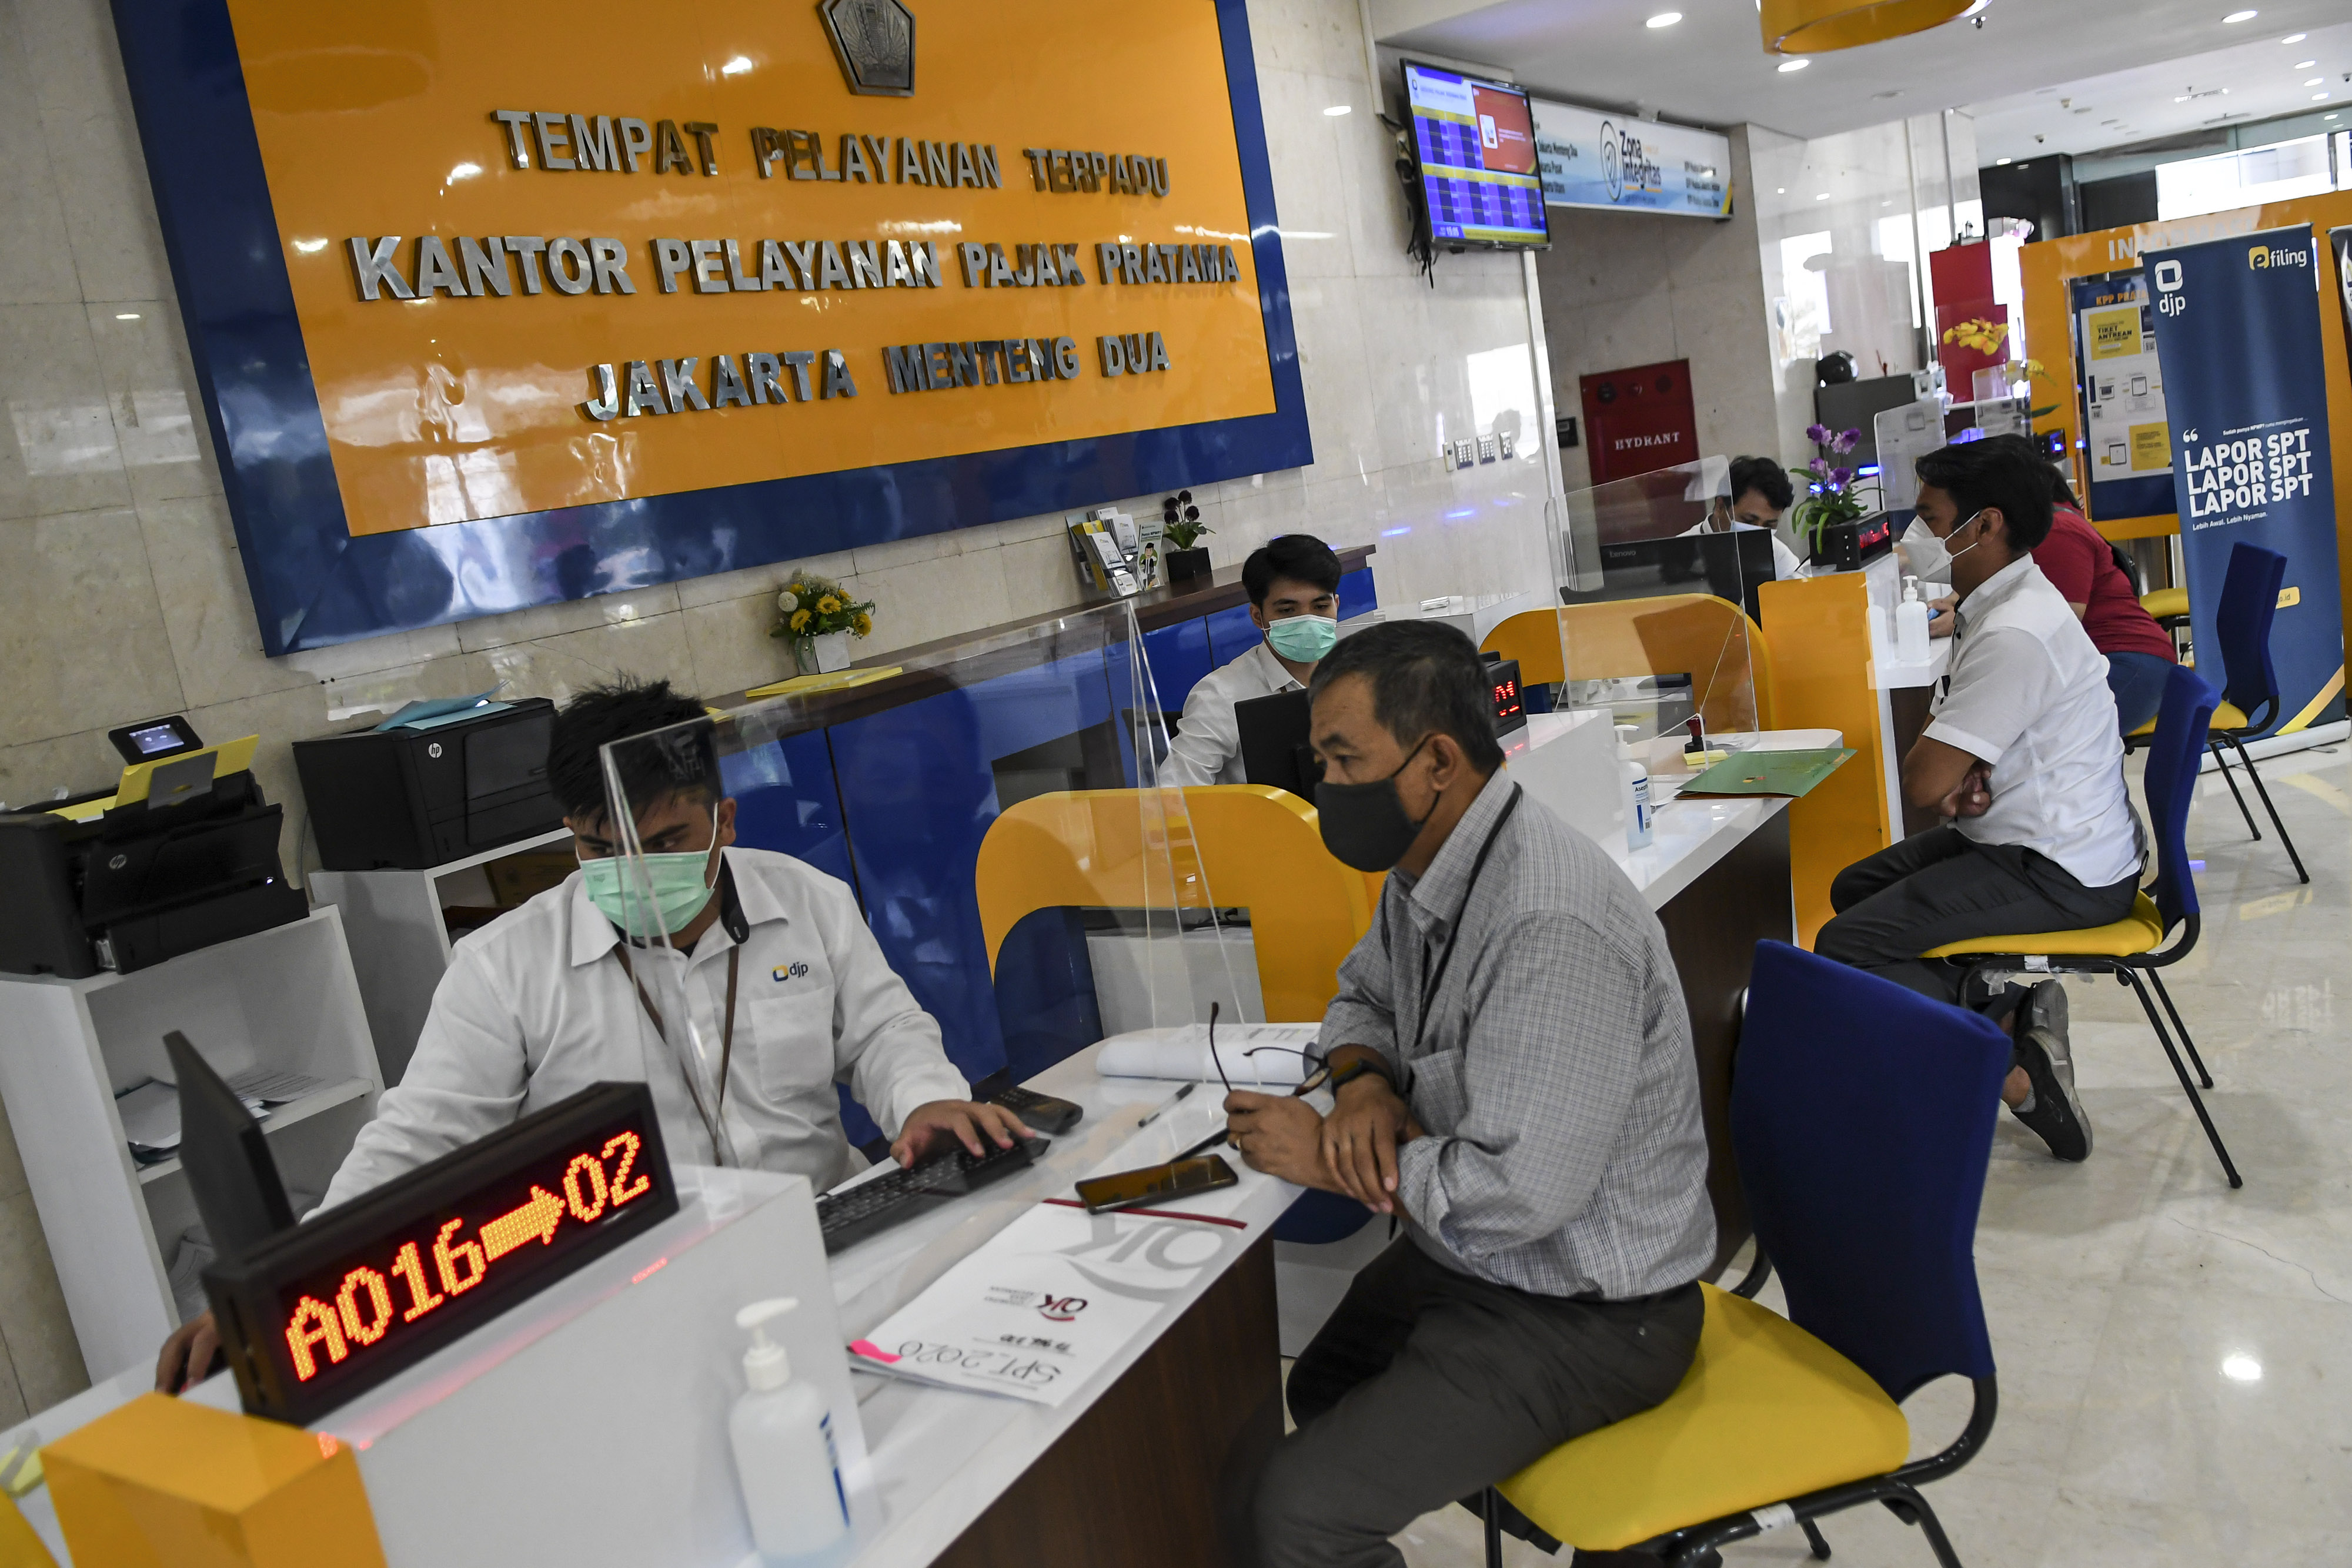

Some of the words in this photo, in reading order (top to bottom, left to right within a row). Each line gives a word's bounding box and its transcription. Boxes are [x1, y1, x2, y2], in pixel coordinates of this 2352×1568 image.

[490, 108, 720, 176] TEMPAT
[751, 127, 1003, 189] PELAYANAN
[1024, 147, 1171, 198] TERPADU
[1619, 130, 1643, 159] Zona
[345, 236, 638, 302] KANTOR
[650, 237, 942, 295] PELAYANAN
[957, 242, 1086, 287] PAJAK
[1095, 242, 1242, 285] PRATAMA
[2159, 293, 2186, 317] djp
[575, 349, 858, 423] JAKARTA
[881, 336, 1081, 394] MENTENG
[1096, 331, 1171, 377] DUA
[1615, 432, 1680, 450] HYDRANT
[2184, 438, 2264, 472] LAPOR
[2267, 429, 2310, 457] SPT
[2187, 460, 2266, 495] LAPOR
[2269, 451, 2311, 480] SPT
[2189, 483, 2267, 517] LAPOR
[2271, 473, 2313, 502] SPT
[2193, 521, 2209, 531] Lebih
[2226, 515, 2243, 524] Lebih
[1609, 550, 1636, 558] Lenovo
[789, 961, 808, 978] djp
[286, 1218, 486, 1382] A016
[563, 1131, 650, 1222] 02
